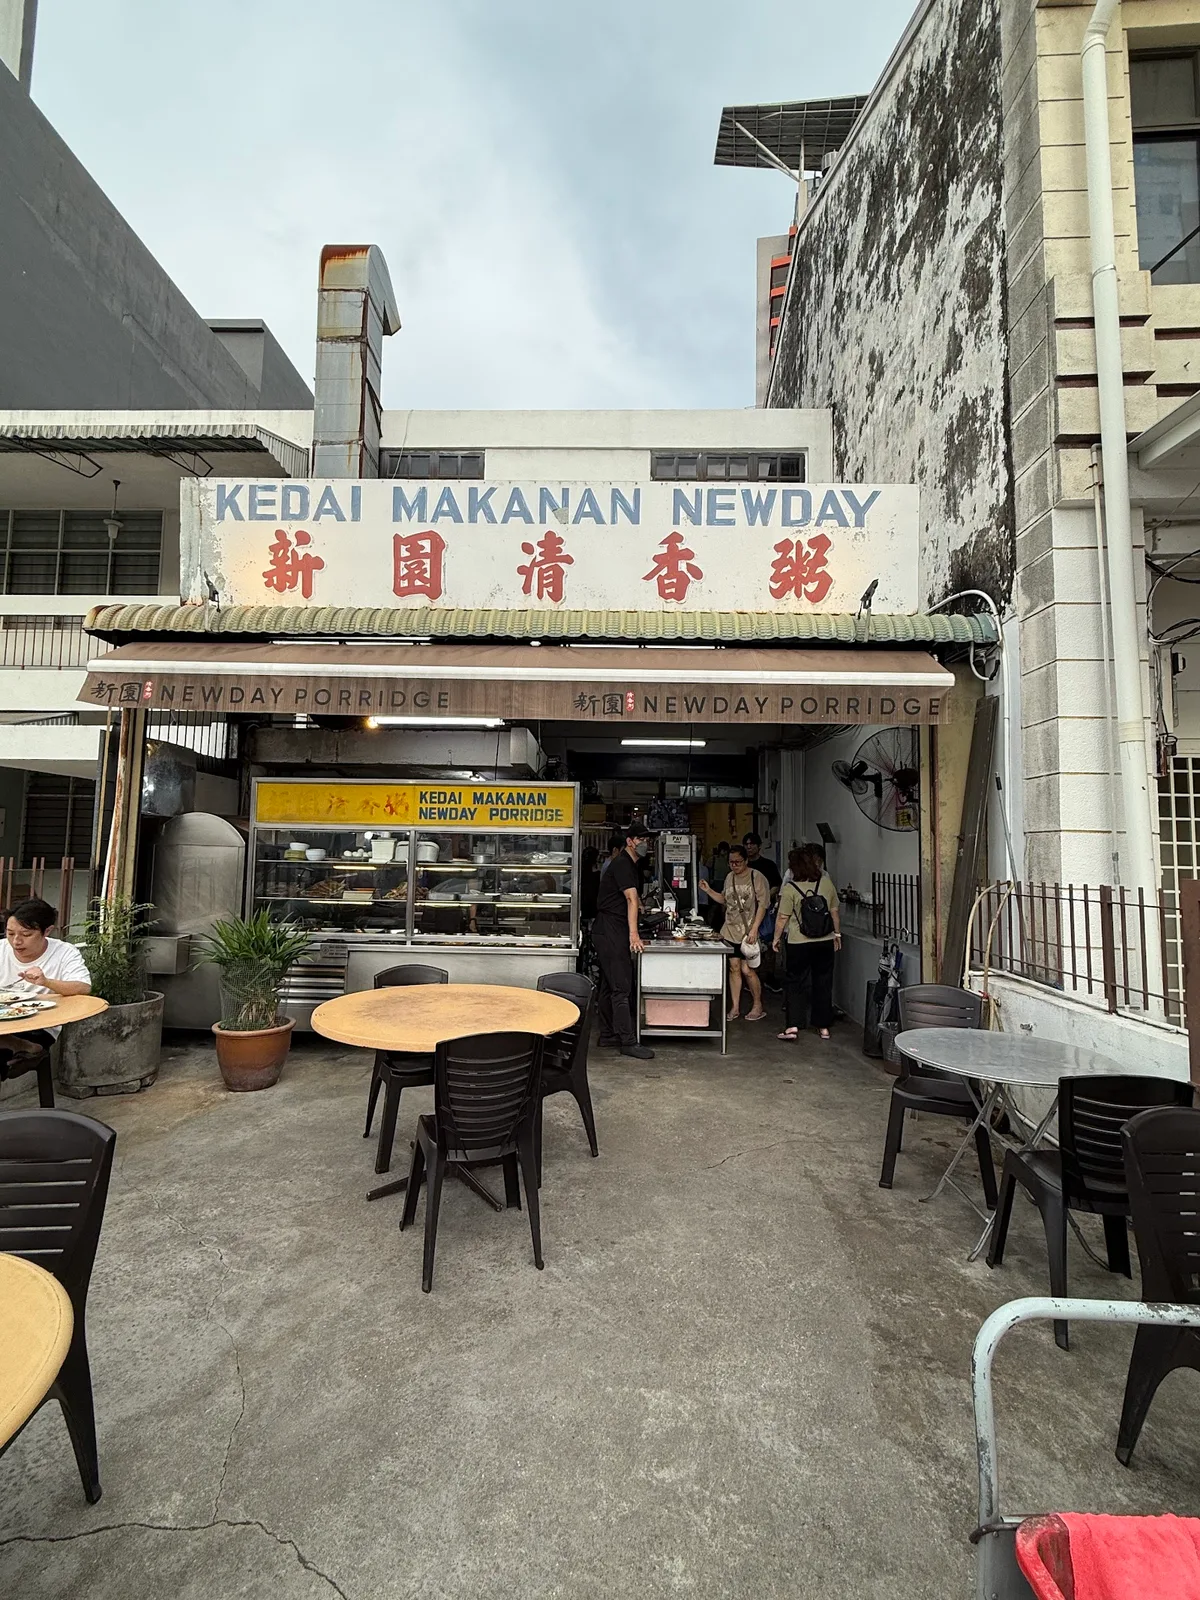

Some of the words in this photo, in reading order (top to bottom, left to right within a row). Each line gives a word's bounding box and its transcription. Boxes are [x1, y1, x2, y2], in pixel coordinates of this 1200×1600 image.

[215, 484, 362, 523] KEDAI
[391, 486, 641, 526] MAKANAN
[673, 488, 882, 528] NEWDAY
[262, 529, 834, 604] 新園清香粥
[90, 680, 142, 704] 新園
[161, 684, 285, 706] NEWDAY
[295, 688, 450, 709] PORRIDGE
[573, 691, 624, 717] 新園
[643, 695, 769, 716] NEWDAY
[781, 696, 941, 716] PORRIDGE
[419, 790, 462, 805] KEDAI
[472, 791, 547, 806] MAKANAN
[418, 806, 478, 821] NEWDAY
[489, 807, 564, 822] PORRIDGE
